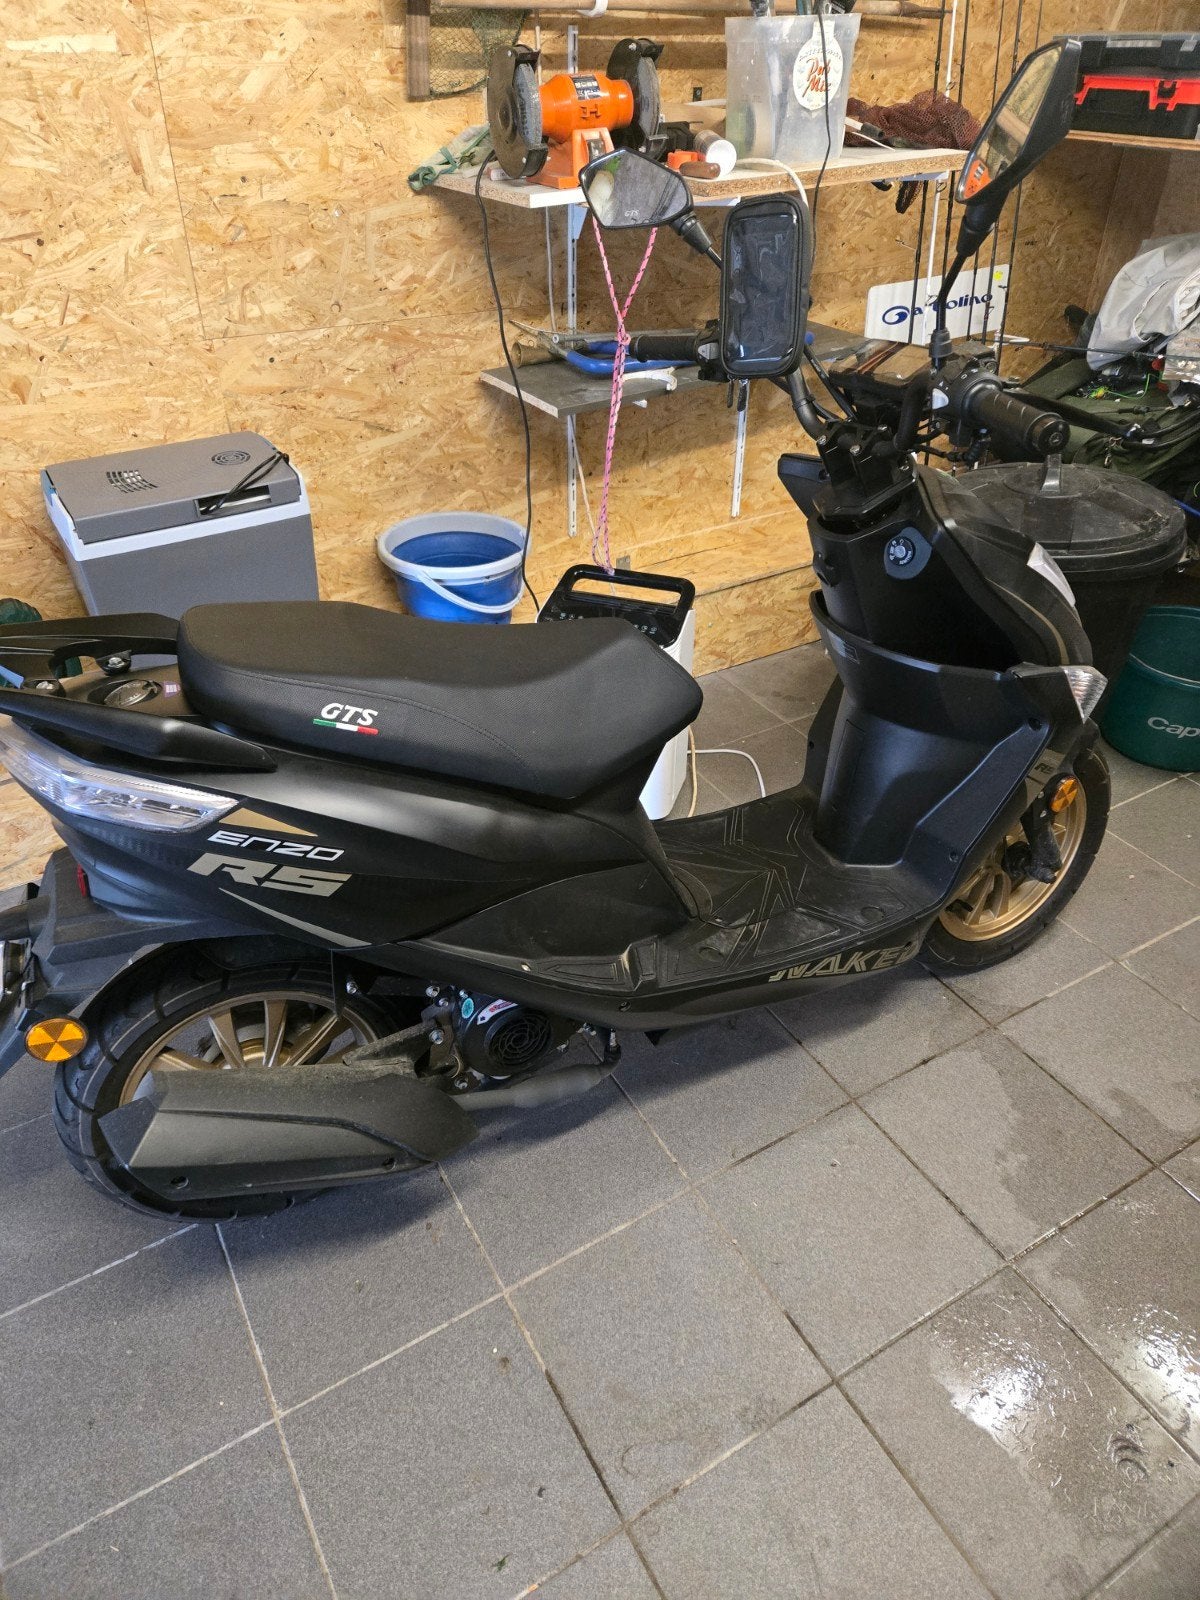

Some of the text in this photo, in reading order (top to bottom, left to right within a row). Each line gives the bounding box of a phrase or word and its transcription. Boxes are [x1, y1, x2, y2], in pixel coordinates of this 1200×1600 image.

[321, 702, 379, 726] GTS
[207, 829, 345, 862] ENZO
[186, 852, 353, 897] RS
